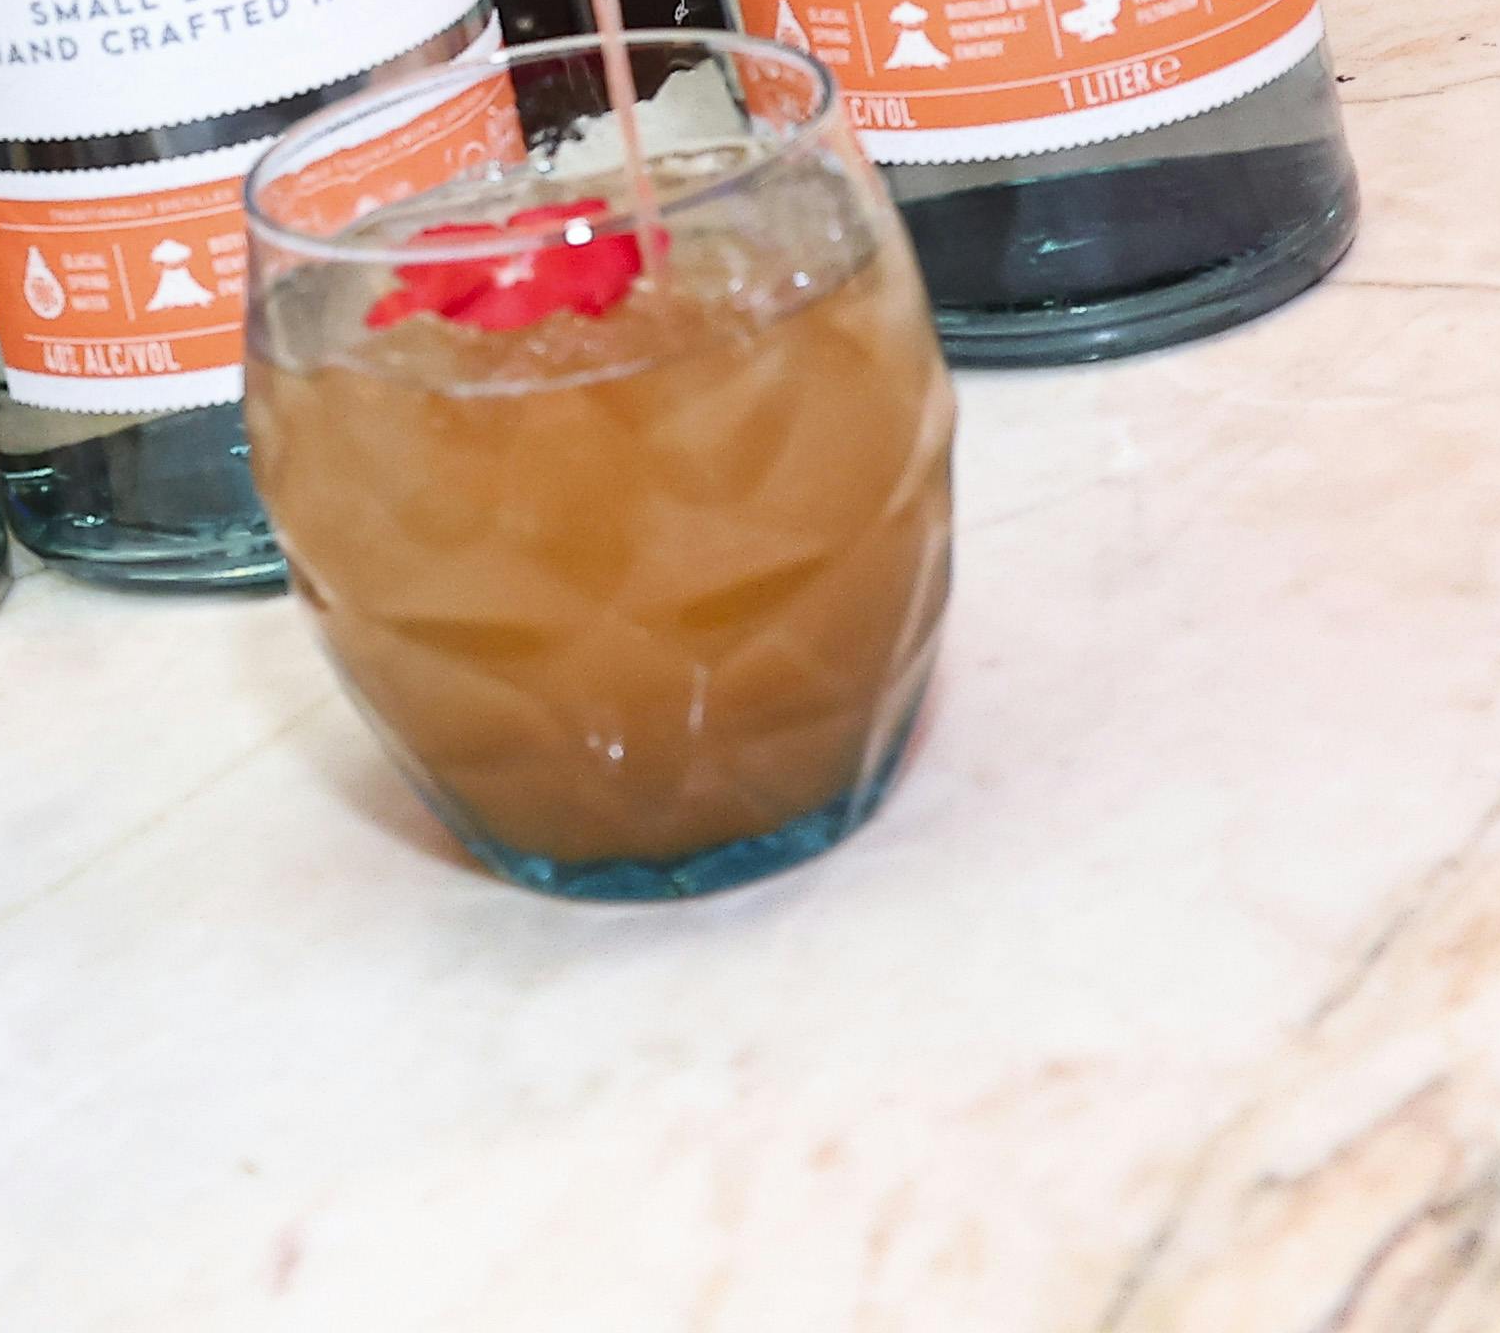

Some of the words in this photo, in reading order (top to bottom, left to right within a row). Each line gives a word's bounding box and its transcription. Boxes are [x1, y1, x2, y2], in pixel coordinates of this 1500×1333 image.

[1060, 79, 1075, 110] 1
[1082, 61, 1150, 106] LITER
[850, 97, 917, 129] C/VOL
